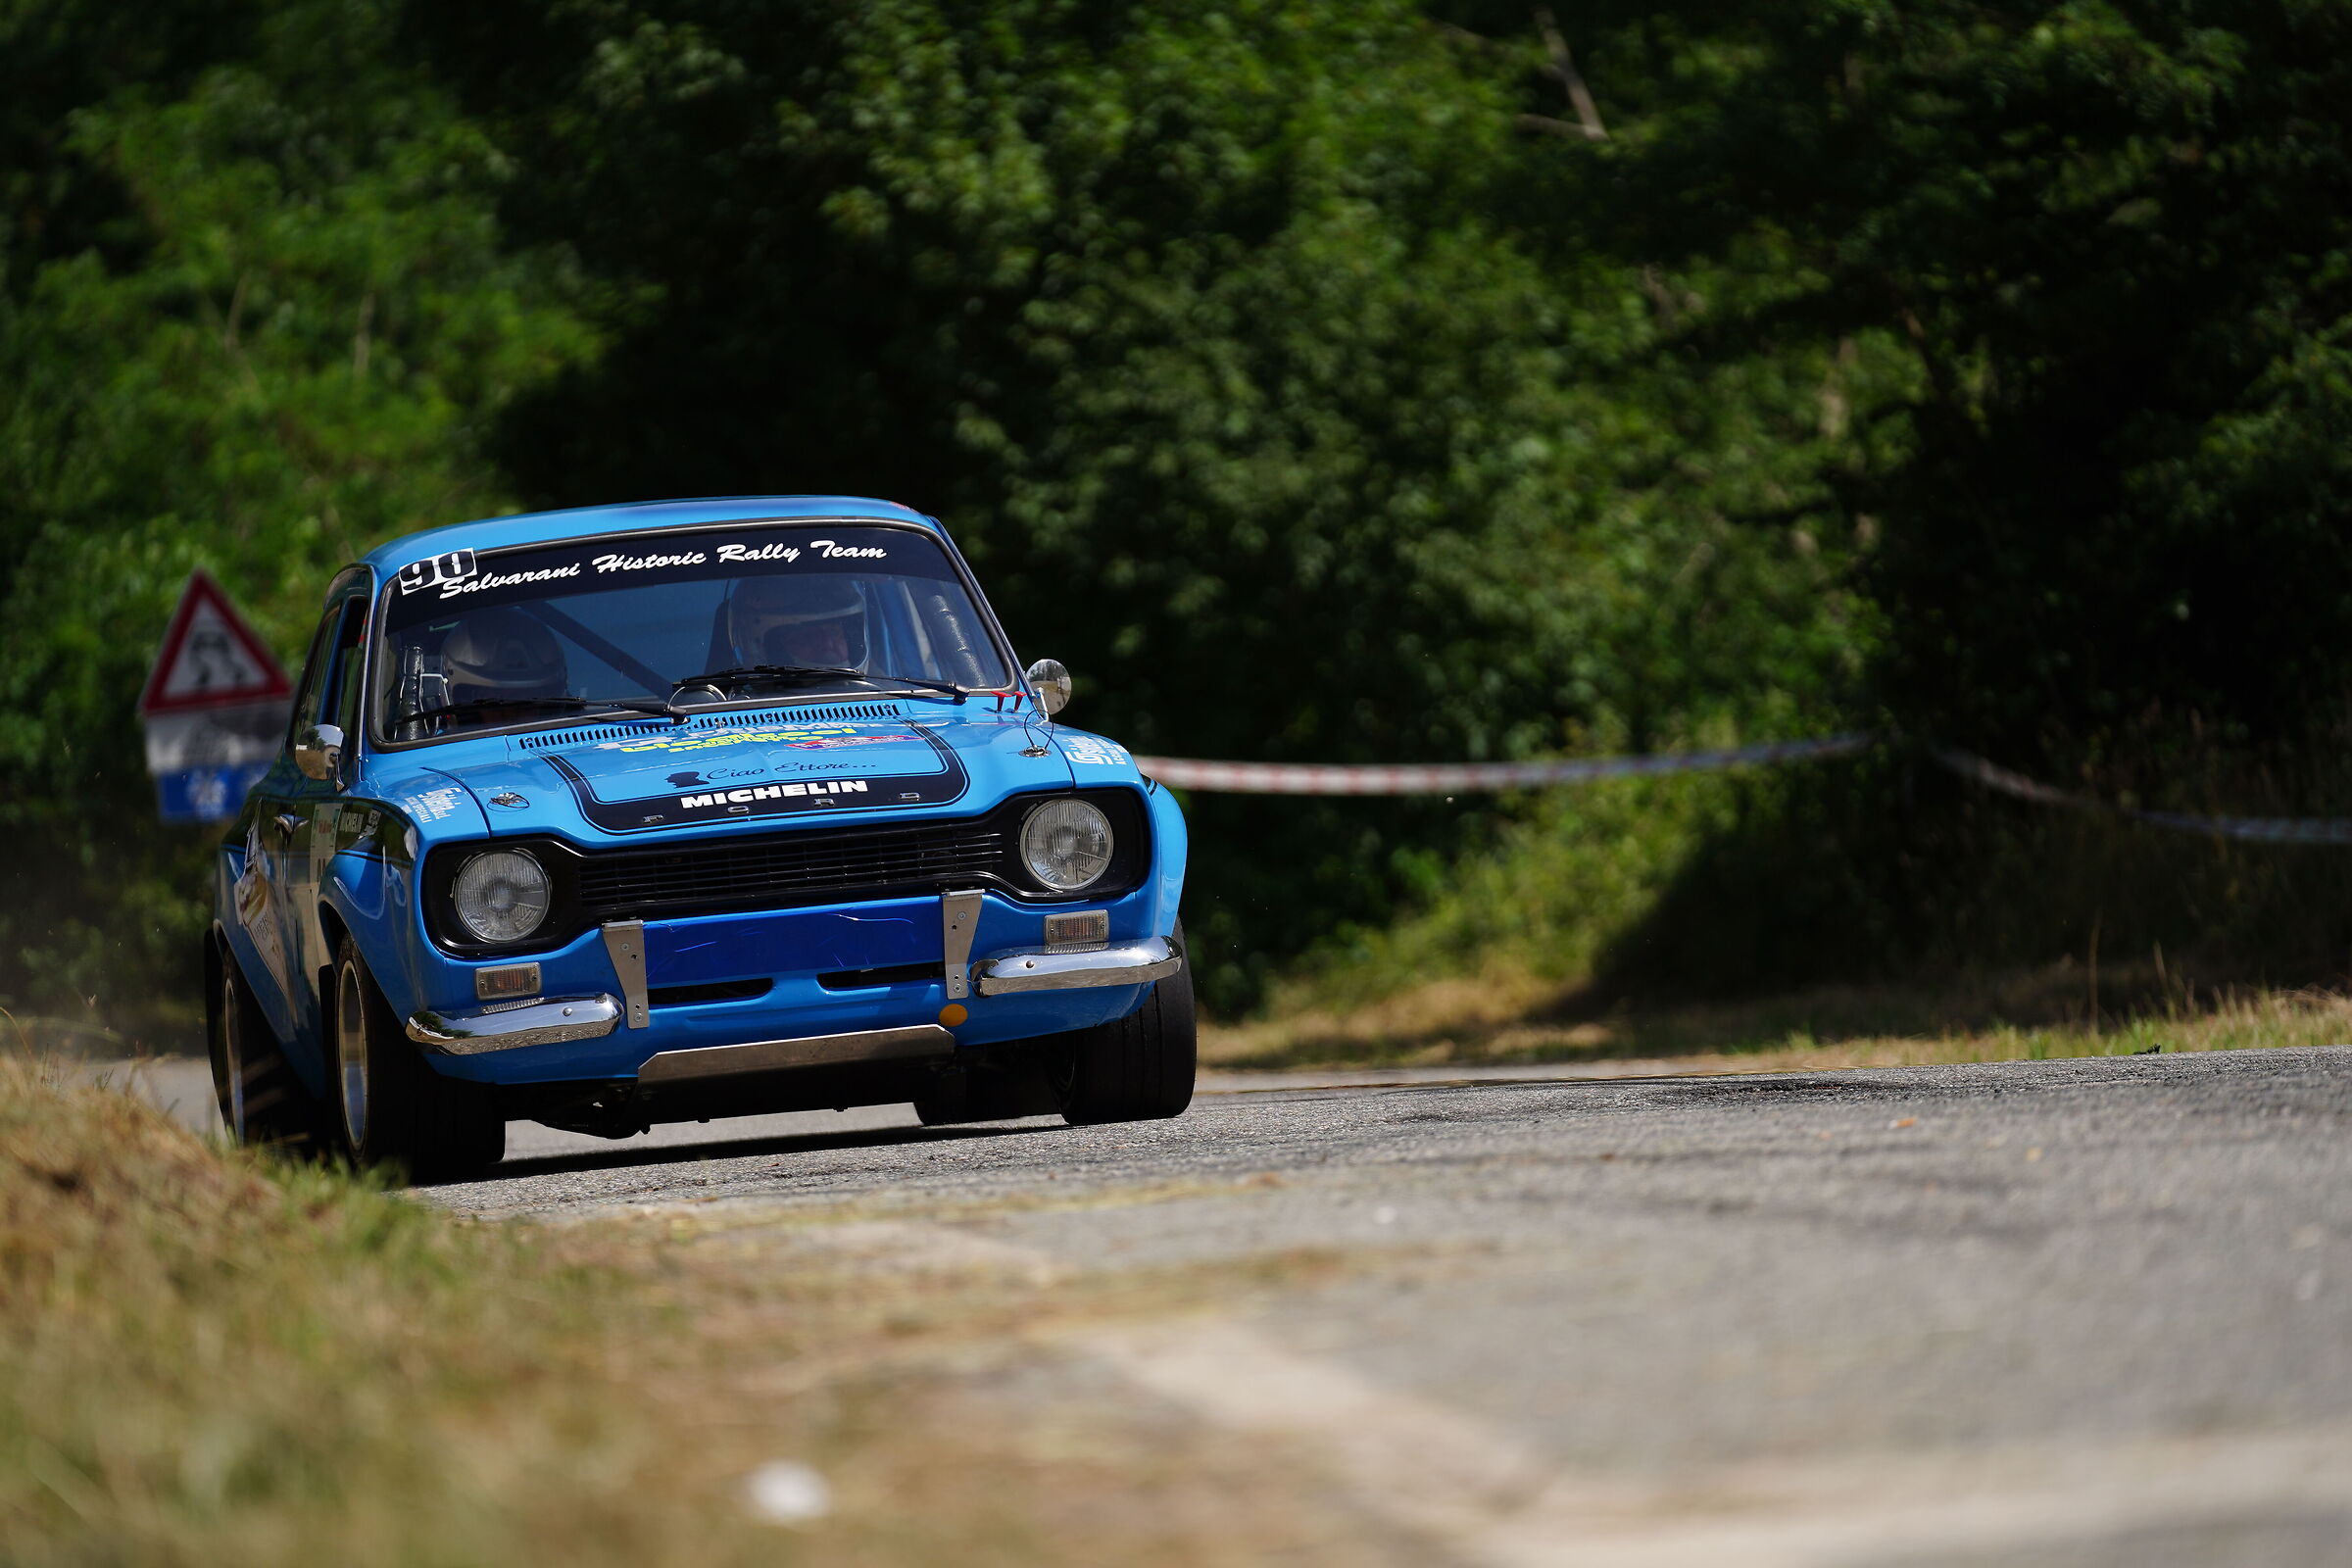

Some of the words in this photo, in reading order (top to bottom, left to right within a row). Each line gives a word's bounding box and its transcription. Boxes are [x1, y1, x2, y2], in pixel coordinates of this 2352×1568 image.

[400, 550, 476, 593] 90
[439, 563, 581, 600] Salvarani
[592, 551, 707, 574] Historic
[716, 543, 801, 564] Rally
[810, 540, 887, 559] Team
[707, 768, 764, 780] Ciao
[680, 780, 868, 809] MICHELIN
